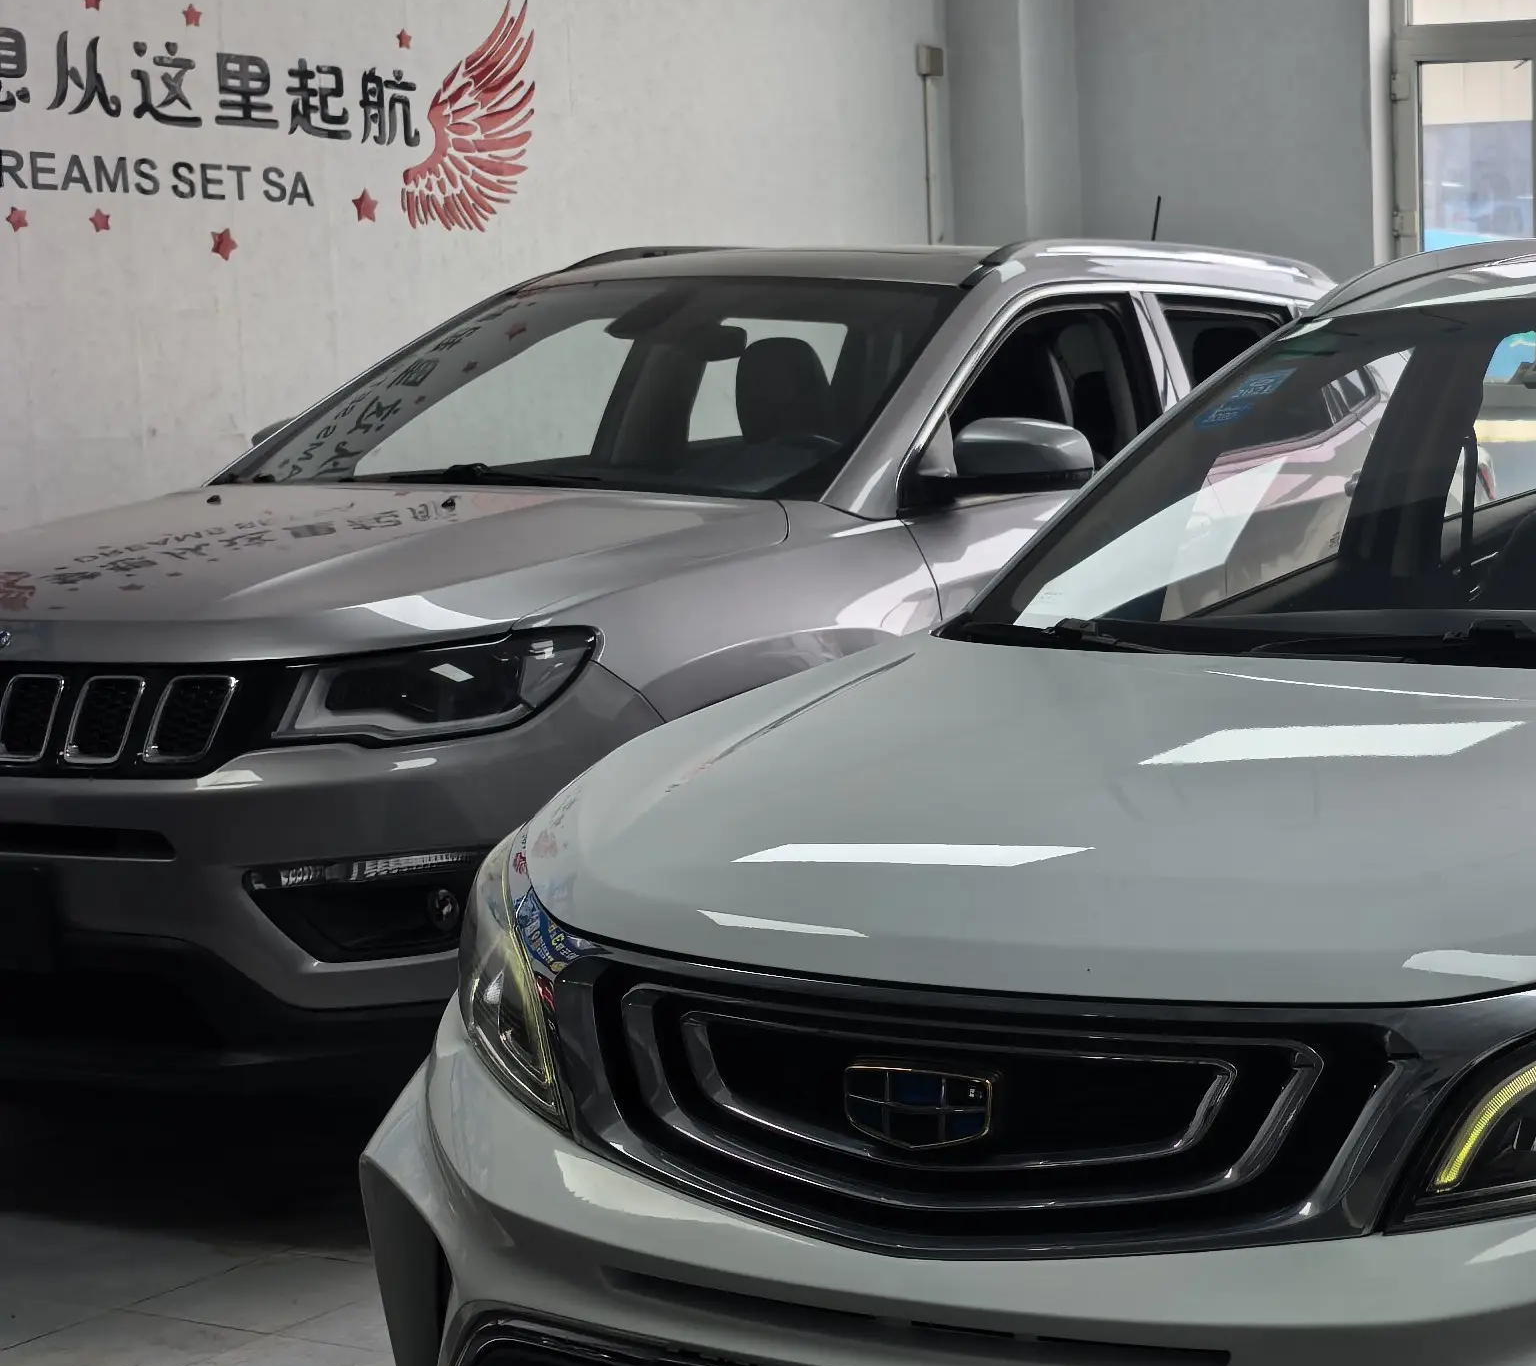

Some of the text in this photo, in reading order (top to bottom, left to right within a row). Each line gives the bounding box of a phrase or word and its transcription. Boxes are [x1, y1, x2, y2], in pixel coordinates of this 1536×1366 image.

[0, 149, 314, 206] REAMS SET SA
